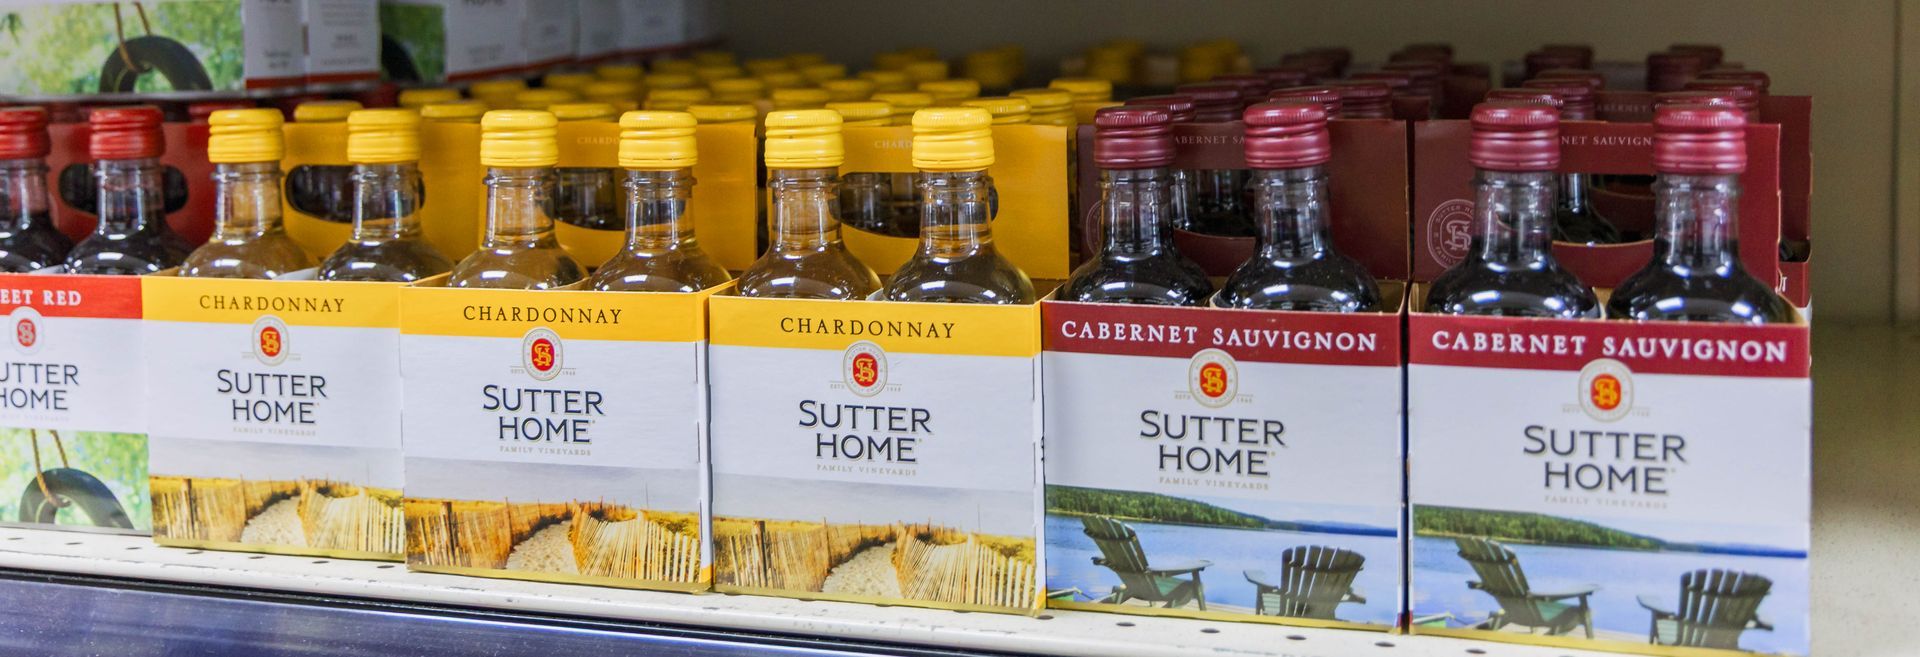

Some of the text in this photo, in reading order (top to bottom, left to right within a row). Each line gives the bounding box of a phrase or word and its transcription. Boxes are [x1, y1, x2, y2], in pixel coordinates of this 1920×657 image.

[1597, 103, 1648, 112] ABERNET
[873, 139, 912, 149] CHARD
[1175, 135, 1228, 145] BERNET
[1592, 135, 1653, 147] SAUVIGN
[43, 290, 82, 306] RED
[199, 295, 345, 313] CHARDONNAY
[463, 305, 621, 324] CHARDONNAY
[780, 317, 955, 339] CHARDONNAY
[1061, 319, 1378, 353] CABERNET SAUVIGNON
[1431, 330, 1788, 363] CABERNET SAUVIGNON
[216, 369, 328, 398] SUTTER
[232, 398, 316, 424] HOME
[482, 384, 605, 416] SUTTER
[798, 399, 932, 433] SUTTER
[1140, 409, 1286, 447] SUTTER
[498, 416, 591, 443] HOME
[500, 445, 592, 457] FAMILY VINEYARDS
[816, 432, 917, 463] HOME
[1522, 424, 1687, 463] SUTTER
[816, 463, 918, 477] FAMILY VINEYARDS
[1158, 444, 1270, 476] HOME
[1159, 477, 1270, 491] FAMILY VINEYARDS
[1543, 461, 1668, 495] HOME
